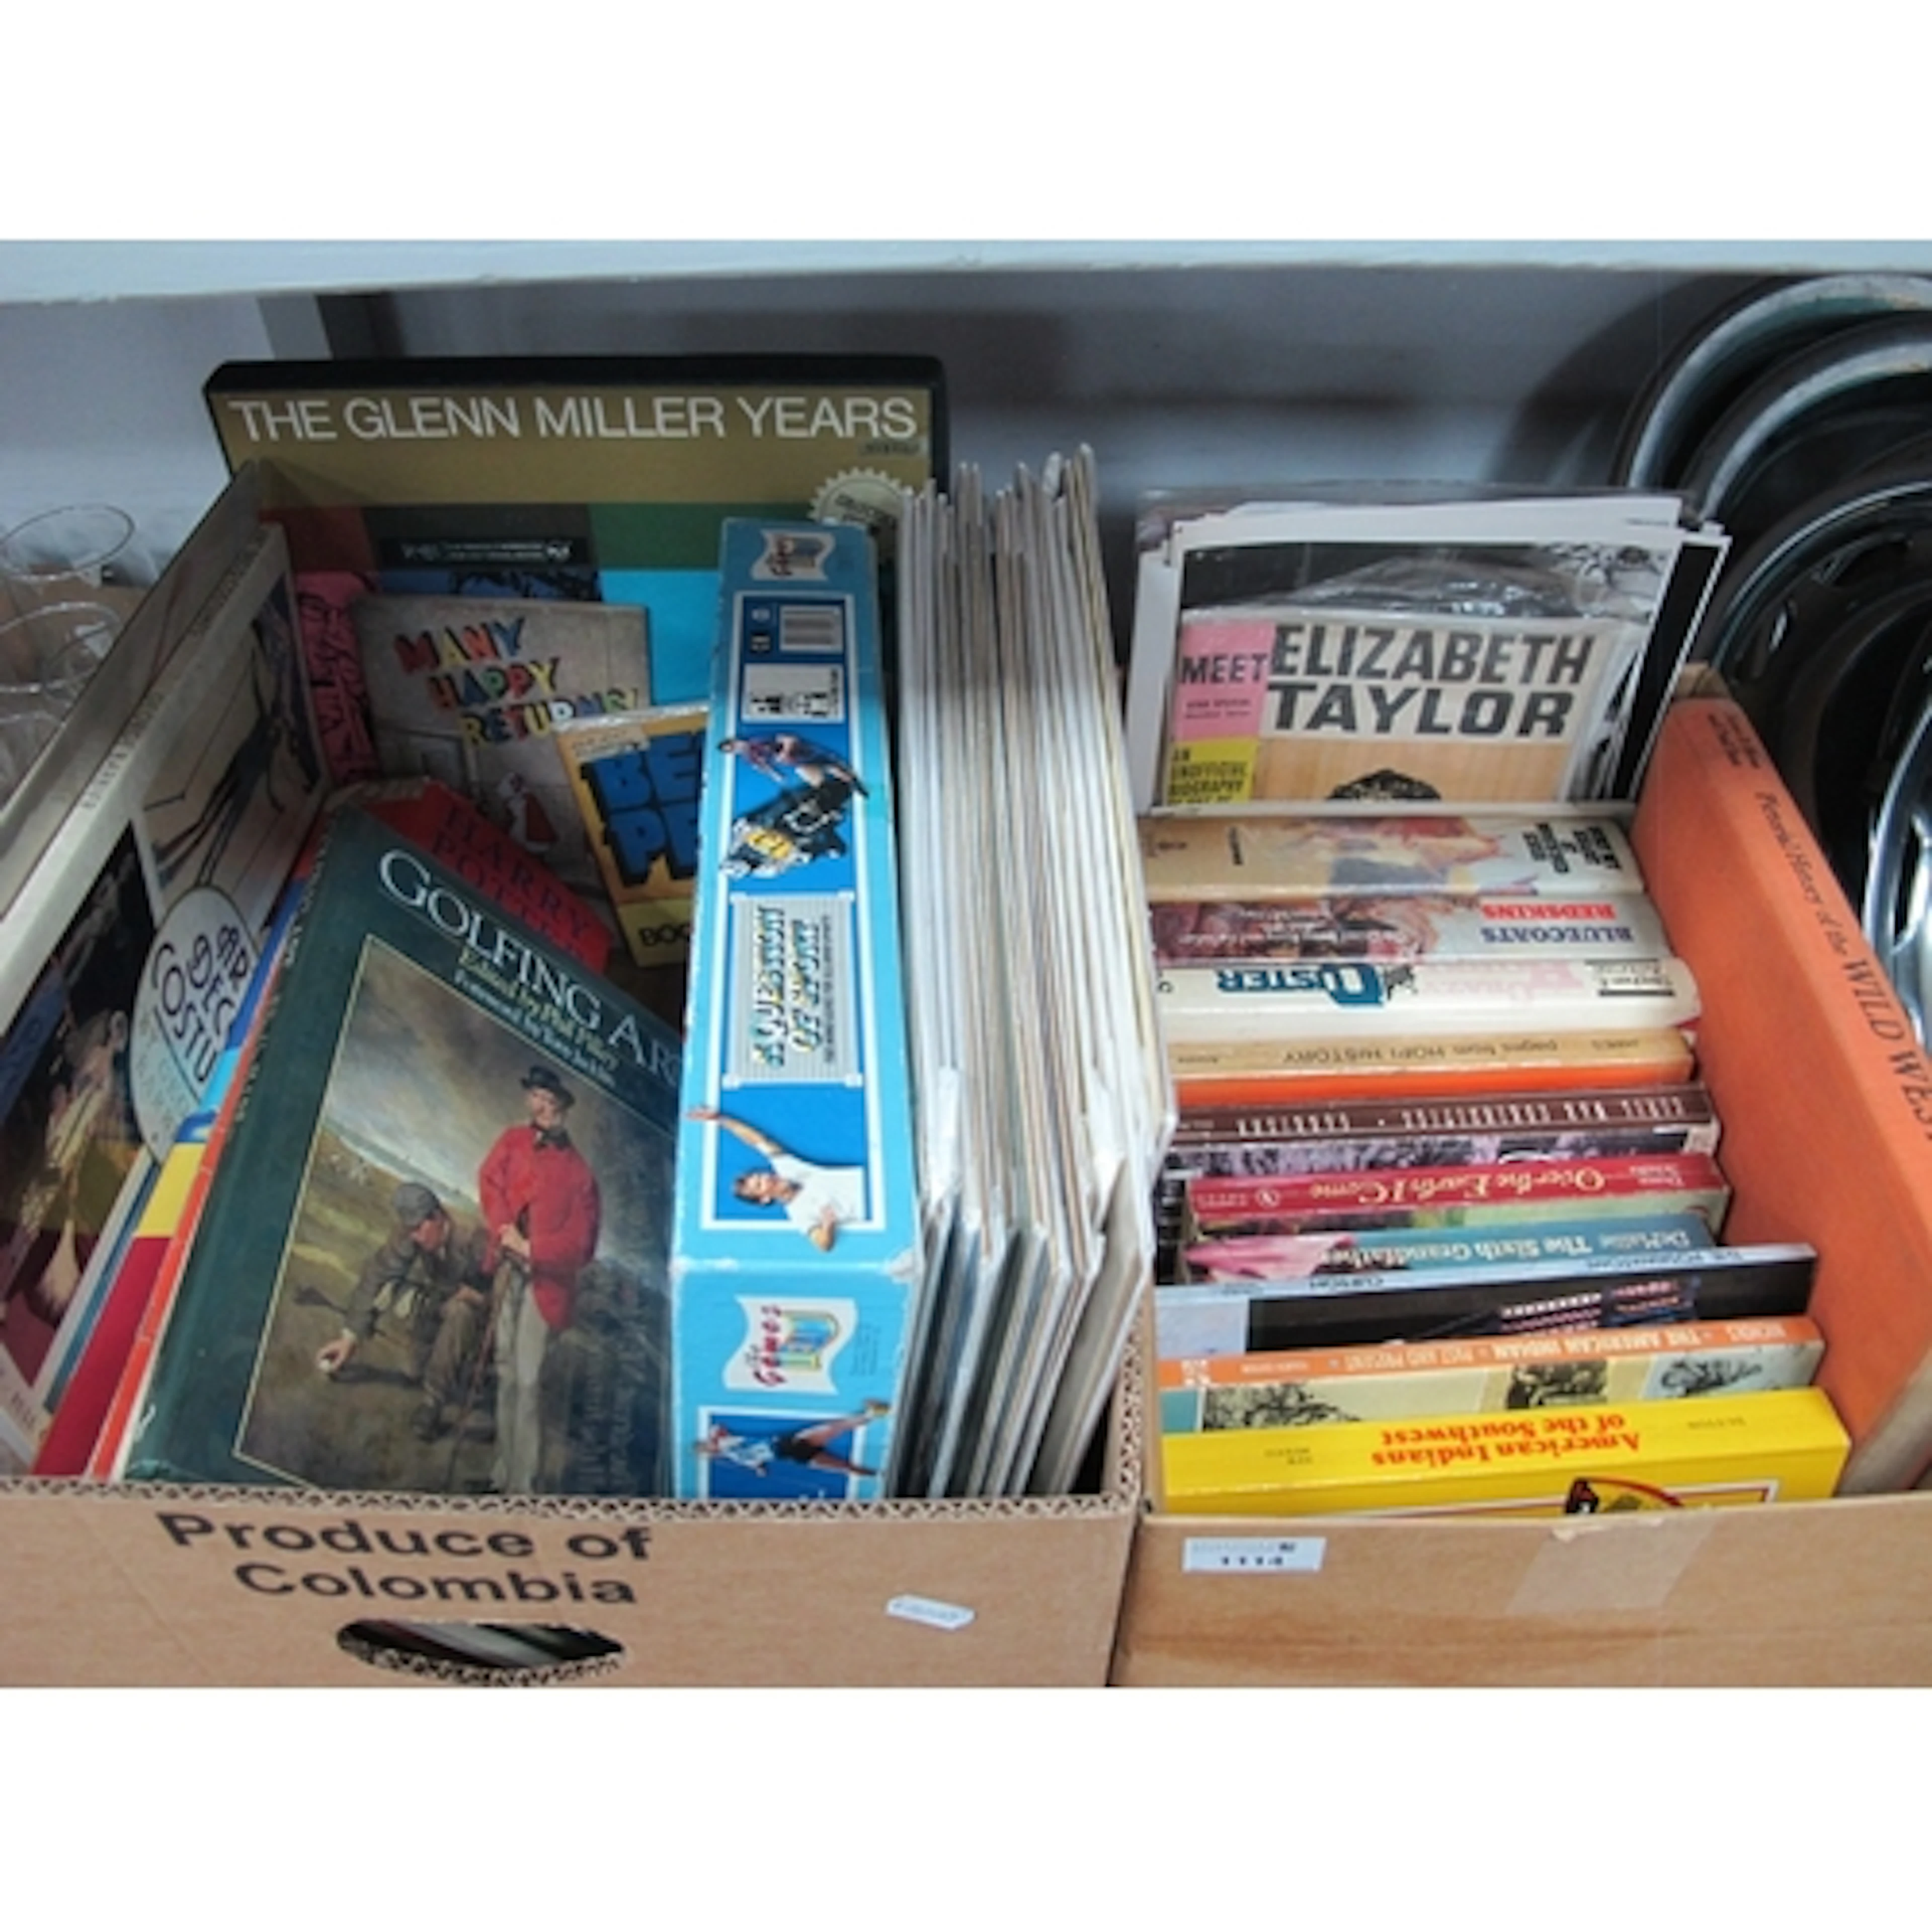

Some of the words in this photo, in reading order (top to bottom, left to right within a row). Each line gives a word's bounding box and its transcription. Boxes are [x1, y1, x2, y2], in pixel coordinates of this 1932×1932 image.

[230, 399, 337, 441] THE
[345, 398, 522, 439] GLENN
[536, 398, 726, 439] MILLER
[739, 397, 917, 439] YEARS
[394, 617, 524, 675] MANY
[1269, 625, 1596, 685] ELIZABETH
[1180, 653, 1268, 684] MEET
[428, 657, 561, 711] HAPPY
[1268, 683, 1575, 737] TAYLOR
[444, 807, 594, 937] HARRY
[1483, 903, 1616, 920] REDSKINS
[380, 850, 601, 1030] GOLFING
[1481, 927, 1633, 943] BLUECOATS
[1791, 852, 1823, 908] History
[1842, 959, 1906, 1042] WILD
[1282, 1049, 1380, 1064] HISTORY
[1389, 1046, 1445, 1061] HOPI
[1309, 1179, 1387, 1206] Come
[1411, 1173, 1493, 1200] Earth
[1496, 1171, 1533, 1194] the
[1536, 1166, 1604, 1193] Over
[1320, 1237, 1471, 1272] Grandfather
[1474, 1236, 1539, 1262] Sixth
[1542, 1232, 1592, 1258] The
[1492, 1337, 1560, 1359] INDIAN
[1563, 1328, 1661, 1354] AMERICAN
[1663, 1326, 1701, 1346] THE
[1406, 1346, 1438, 1365] AND
[1381, 1416, 1537, 1450] Southwest
[1541, 1413, 1588, 1436] the
[1591, 1410, 1626, 1433] of
[1370, 1440, 1490, 1472] Indians
[1493, 1429, 1641, 1465] American
[155, 1512, 532, 1558] Produce
[568, 1527, 653, 1560] of
[234, 1564, 637, 1604] Colombia
